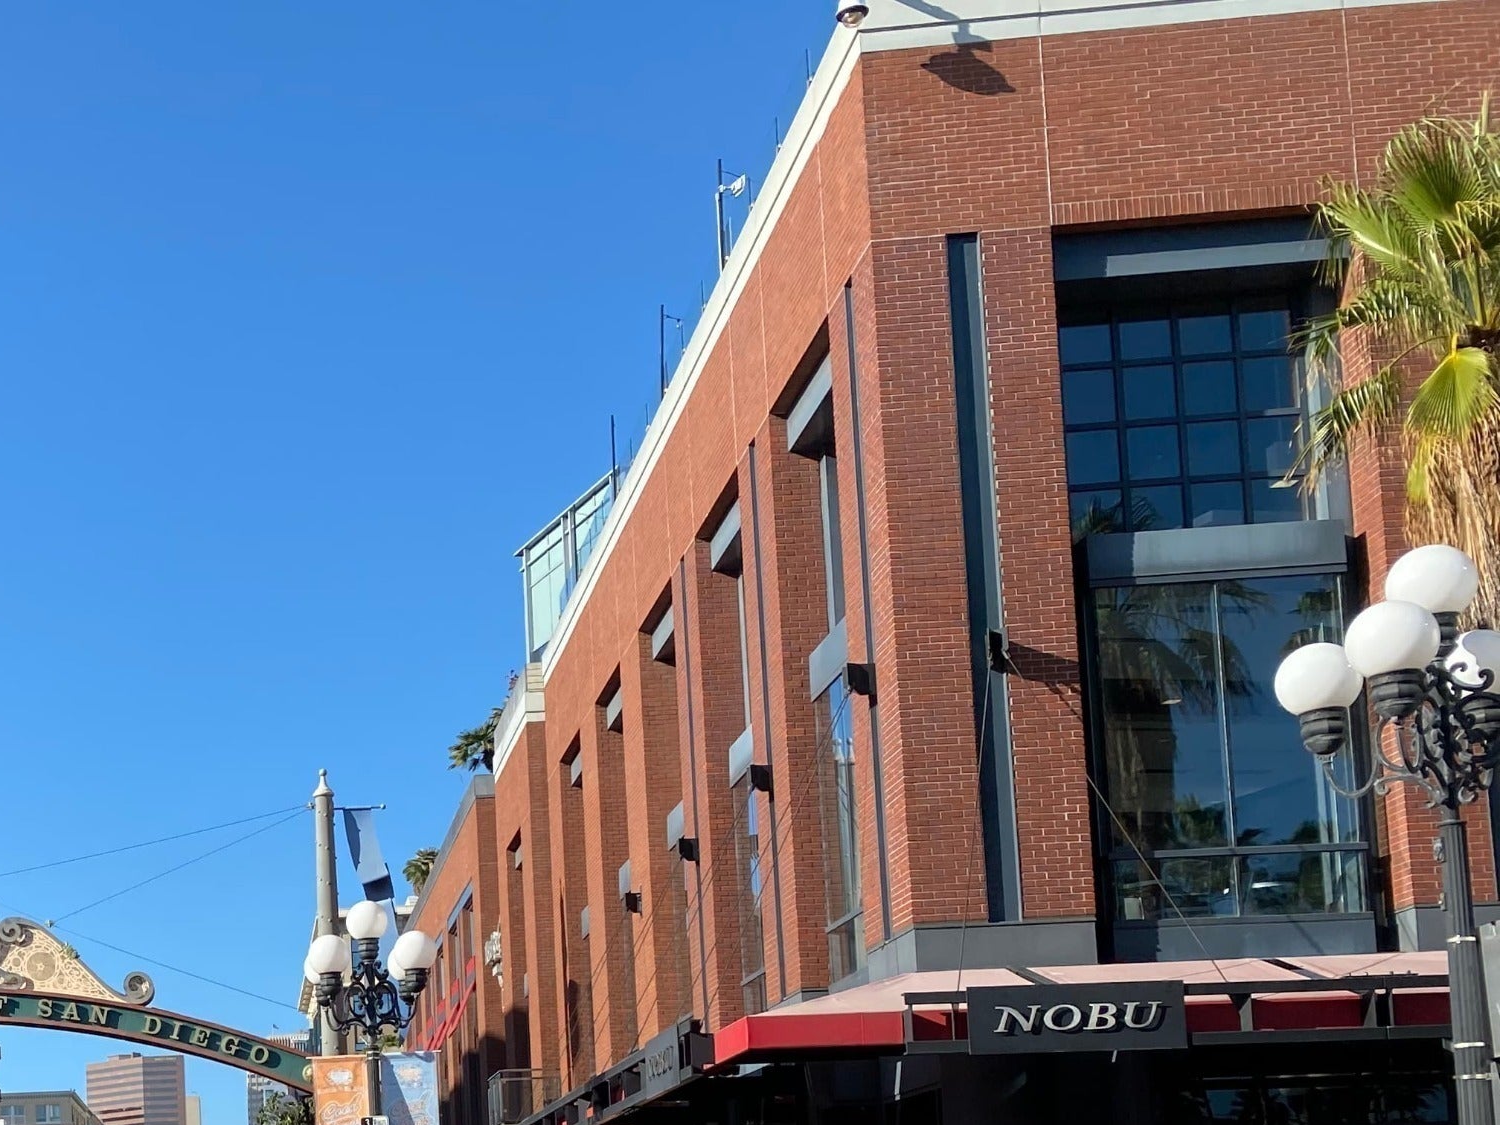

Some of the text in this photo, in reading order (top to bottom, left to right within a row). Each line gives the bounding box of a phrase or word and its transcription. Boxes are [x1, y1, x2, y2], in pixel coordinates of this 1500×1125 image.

[37, 1000, 109, 1026] SAN
[141, 1015, 271, 1065] DIEGO
[993, 1001, 1164, 1033] NOBU
